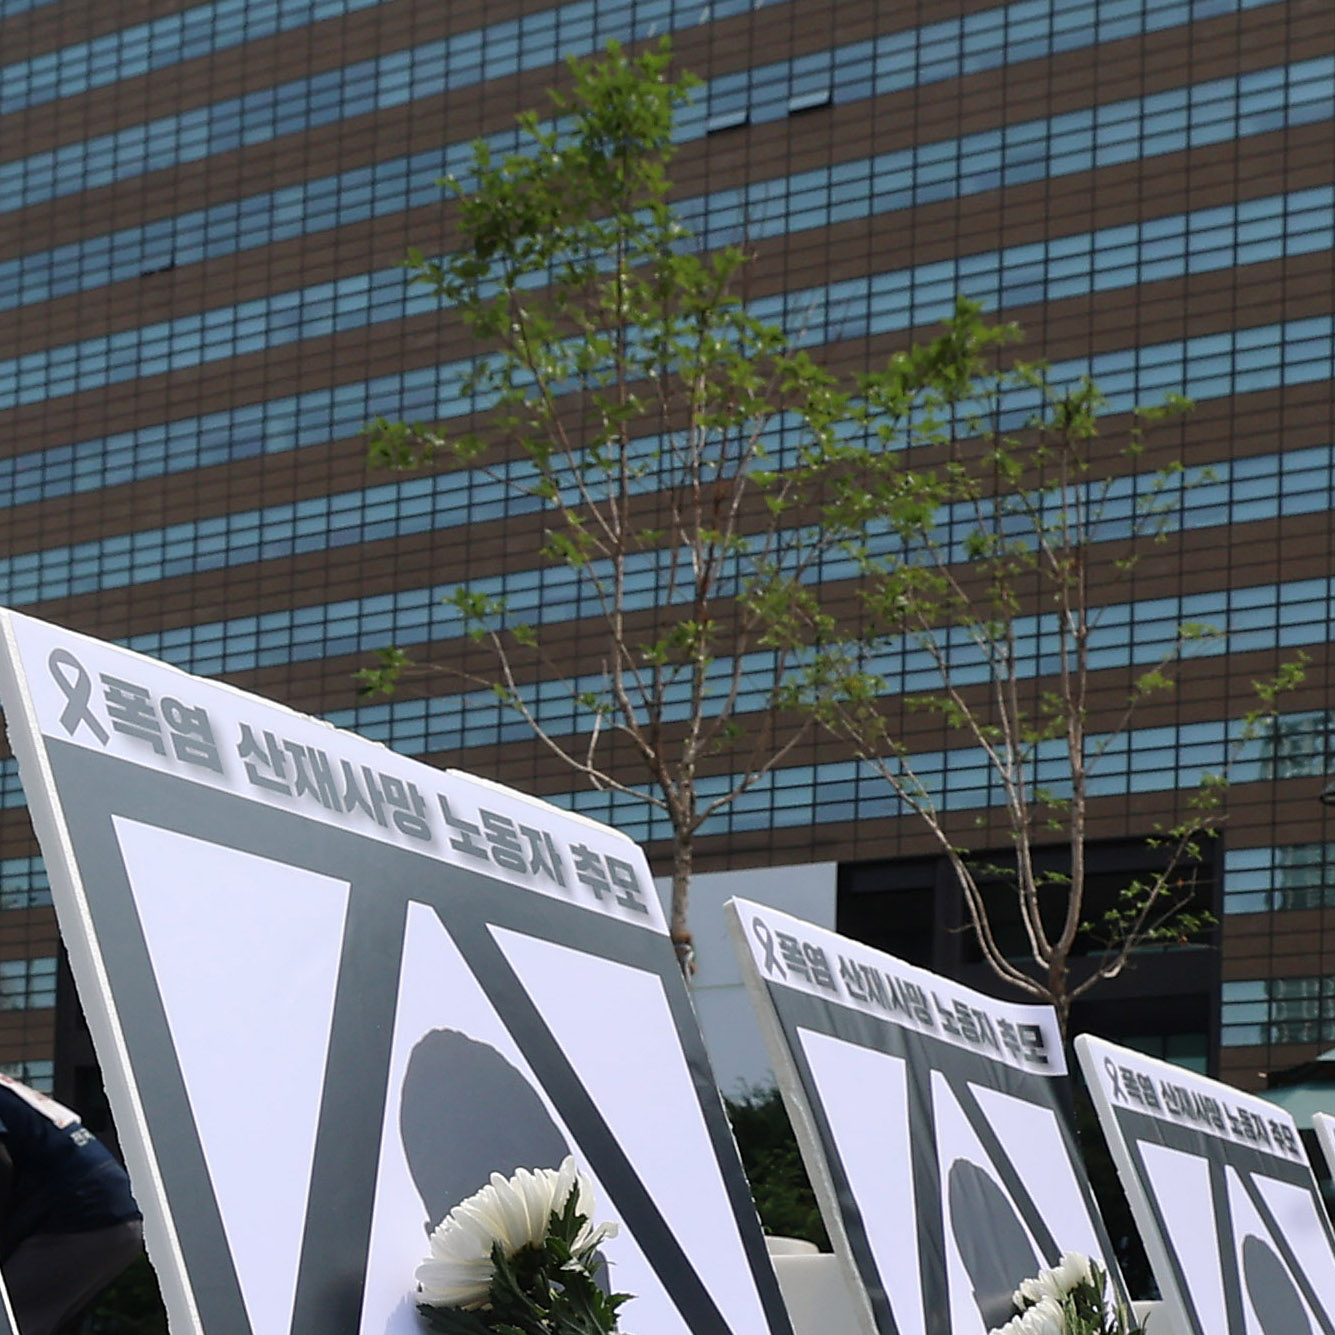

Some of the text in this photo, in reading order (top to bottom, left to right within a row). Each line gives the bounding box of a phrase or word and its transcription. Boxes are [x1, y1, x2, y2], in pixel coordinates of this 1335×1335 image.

[100, 672, 650, 916] 폭염 산재사망 노동자 추모
[775, 930, 1049, 1065] 폭염 산재사망 노동자 추모
